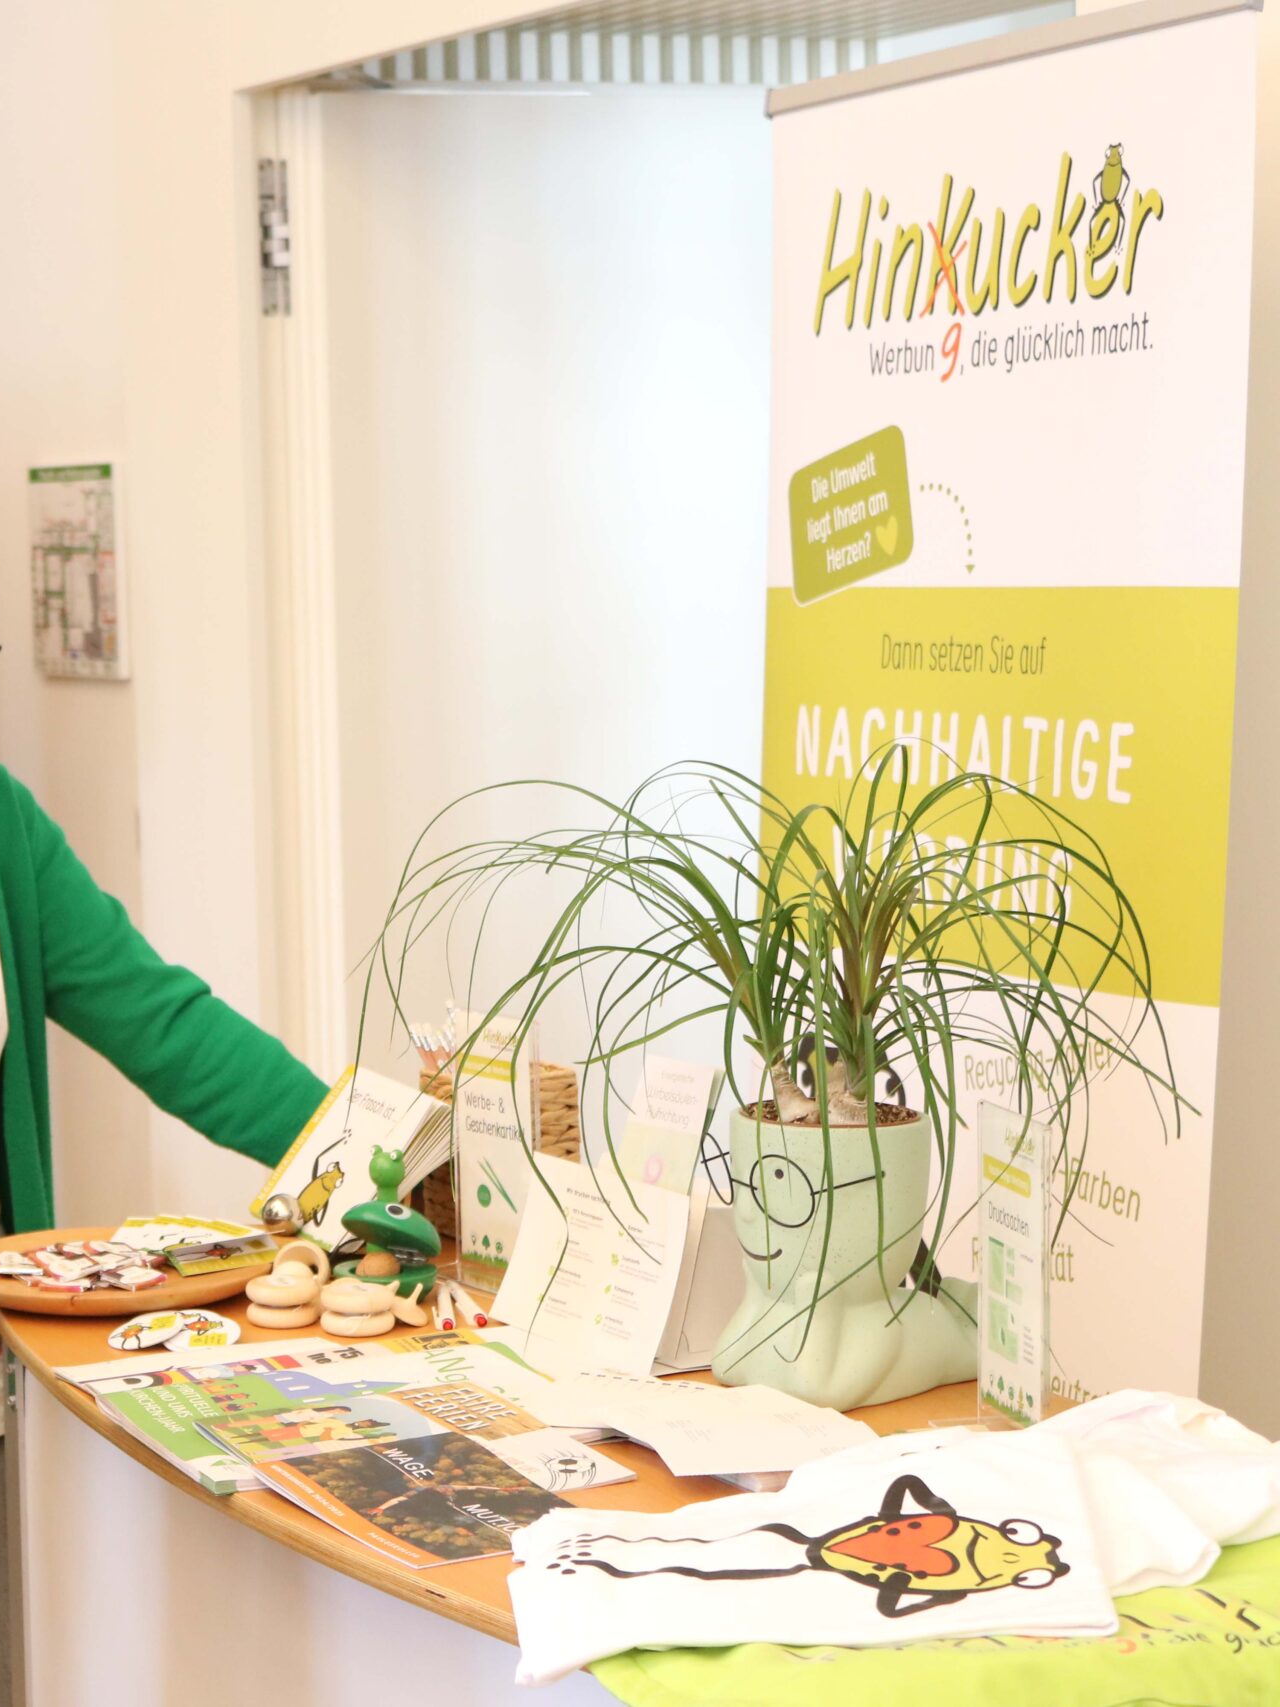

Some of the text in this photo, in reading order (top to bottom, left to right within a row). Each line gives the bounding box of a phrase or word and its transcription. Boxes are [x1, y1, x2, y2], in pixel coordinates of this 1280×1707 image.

[971, 331, 998, 369] die
[1005, 319, 1085, 373] glücklich
[1091, 312, 1154, 356] macht.
[811, 451, 876, 503] Die Umwelt
[807, 491, 888, 544] liegt Ihnen am
[826, 530, 872, 574] Herzen?
[881, 633, 1048, 675] Dann setzen Sie auf
[794, 704, 1135, 804] NACHHALTIGE
[964, 1037, 1113, 1098] Recycg-aier
[363, 1094, 385, 1117] Frosch
[464, 1090, 505, 1114] Werbe- &
[1052, 1155, 1142, 1222] -Farben
[988, 1200, 1029, 1239] Drucksachen
[402, 1390, 493, 1432] FERIEN
[442, 1387, 518, 1421] FAIRE
[383, 1446, 436, 1480] WAGE.
